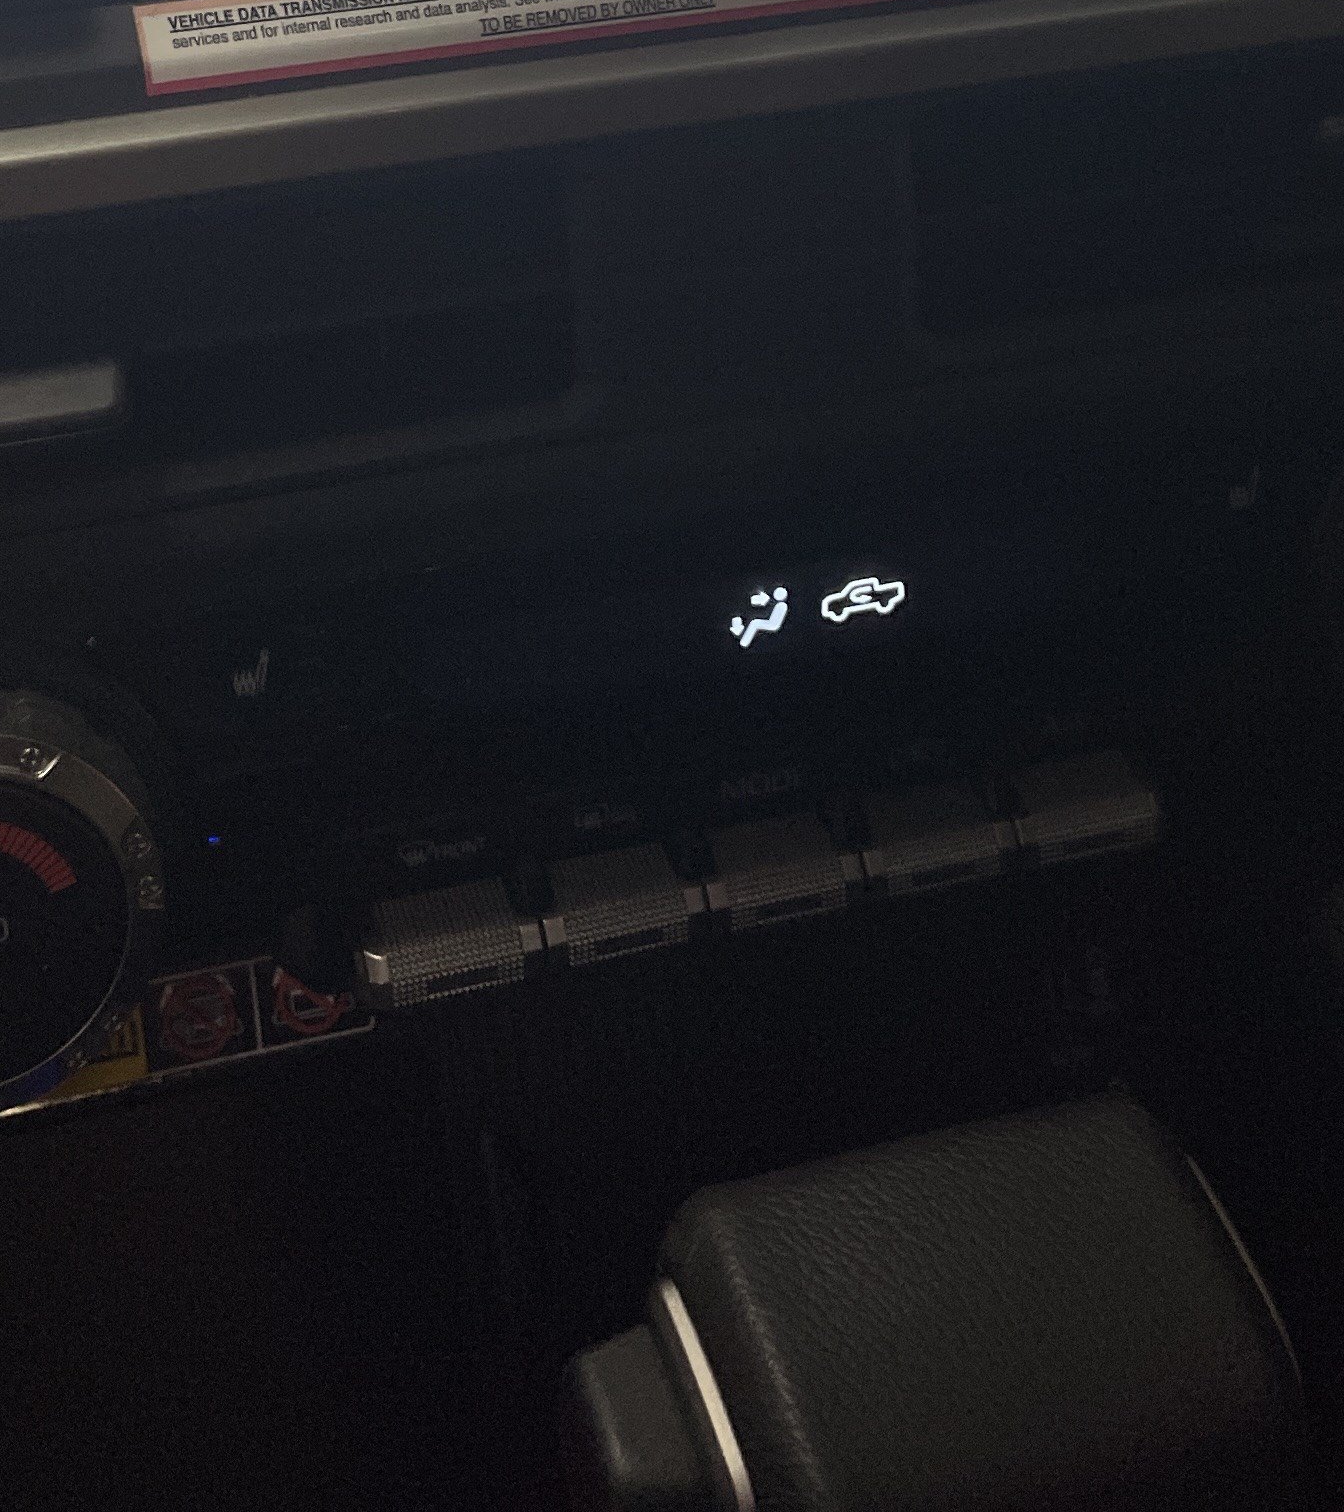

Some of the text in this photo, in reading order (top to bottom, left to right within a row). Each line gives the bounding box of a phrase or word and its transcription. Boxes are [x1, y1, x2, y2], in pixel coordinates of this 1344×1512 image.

[168, 9, 234, 31] VEHICLE
[237, 5, 278, 23] DATA
[171, 34, 229, 50] services
[233, 28, 257, 43] and
[260, 25, 278, 39] for
[282, 18, 331, 36] internal
[335, 11, 393, 30] research
[396, 7, 421, 22] and
[424, 3, 453, 19] data
[480, 17, 500, 33] TO
[504, 14, 523, 29] BE
[526, 6, 597, 27] REMOVED
[601, 2, 620, 17] BY
